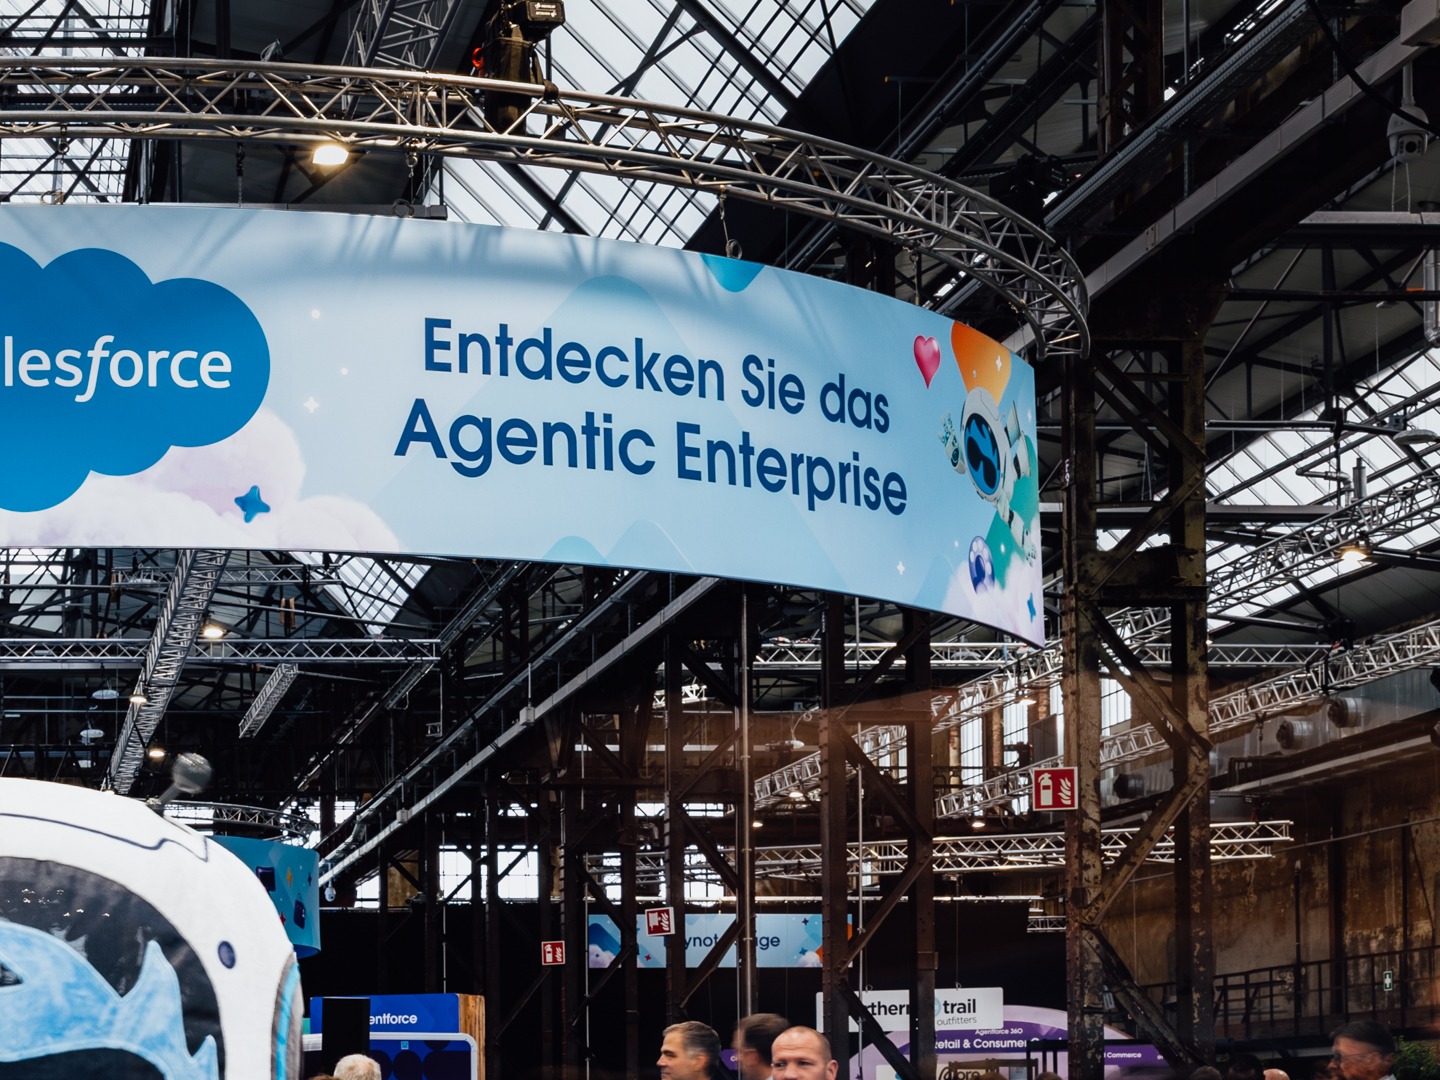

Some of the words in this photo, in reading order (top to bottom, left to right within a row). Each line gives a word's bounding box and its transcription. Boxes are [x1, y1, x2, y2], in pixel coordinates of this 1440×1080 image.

[423, 317, 725, 402] Entdecken
[740, 354, 806, 415] Sie
[819, 373, 891, 434] das
[394, 397, 656, 479] Agentic
[675, 421, 908, 516] Enterprise
[943, 998, 977, 1015] trail
[369, 1013, 418, 1025] entforce
[936, 1016, 978, 1026] outfitters
[962, 1039, 971, 1049] &
